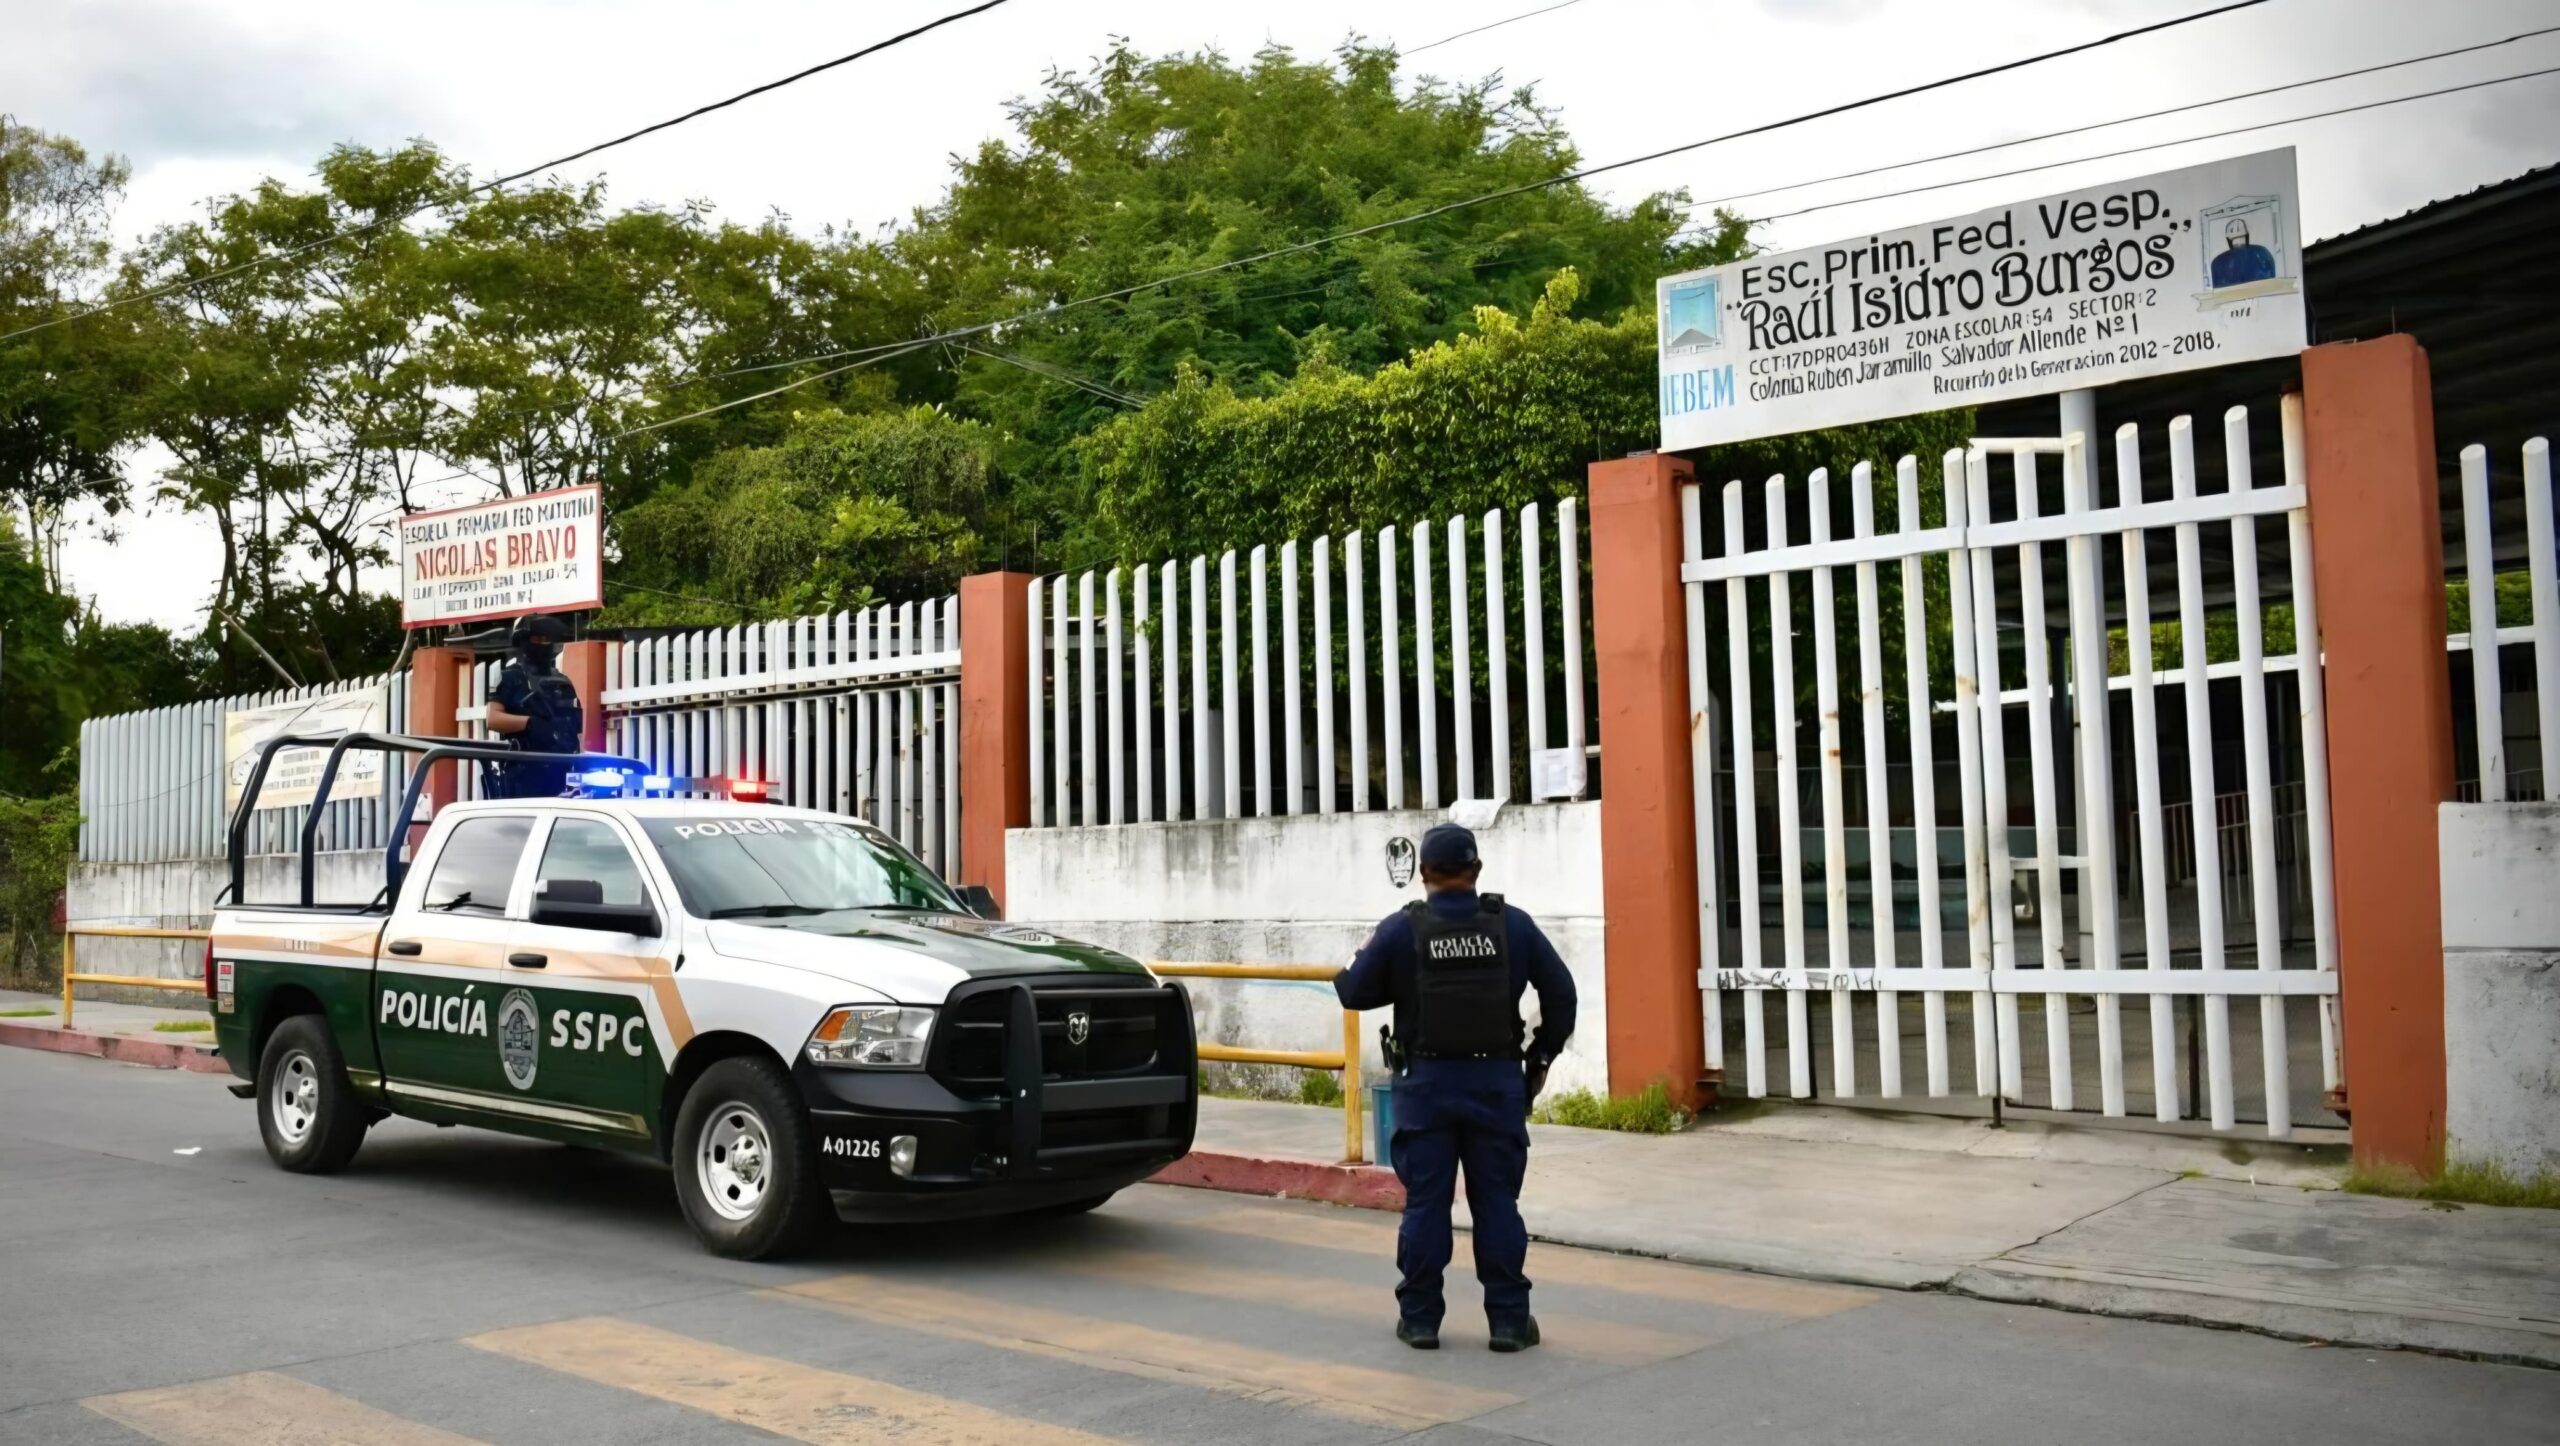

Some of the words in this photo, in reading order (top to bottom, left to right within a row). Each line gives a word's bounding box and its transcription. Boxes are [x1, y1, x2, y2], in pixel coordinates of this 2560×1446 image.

[1849, 267, 1984, 332] Isidro
[1856, 350, 1932, 384] Jaramillo
[1942, 338, 2014, 367] Salvador
[2019, 324, 2087, 354] Allende
[1906, 326, 1951, 349] ZONA
[1663, 364, 1735, 417] IEBEM
[415, 537, 497, 581] NICOLAS
[507, 525, 577, 569] BRAVO
[381, 984, 488, 1037] POLICÍA
[550, 1009, 645, 1057] SSPC
